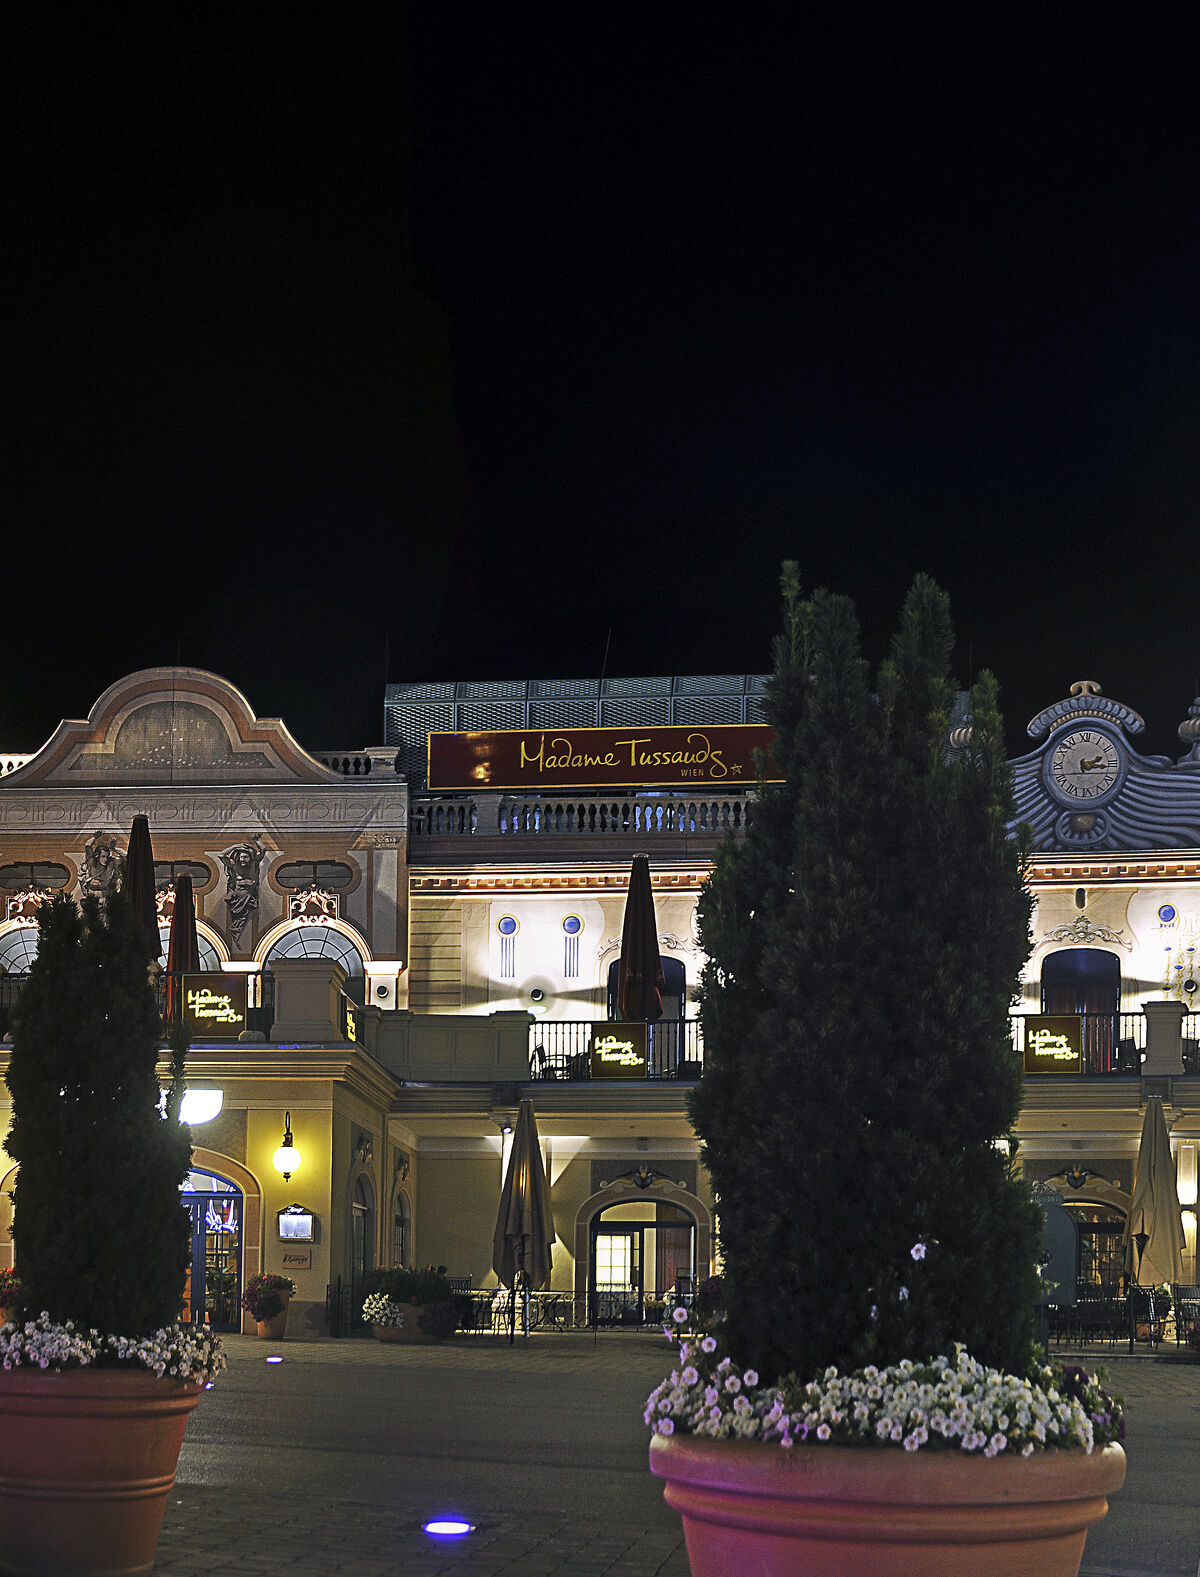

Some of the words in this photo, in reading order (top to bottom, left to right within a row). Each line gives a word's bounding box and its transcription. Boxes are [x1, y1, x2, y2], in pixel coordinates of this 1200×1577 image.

[520, 732, 620, 773] Madame
[615, 733, 728, 778] Tussauds
[680, 768, 704, 777] WIEN
[187, 989, 232, 1005] Madame
